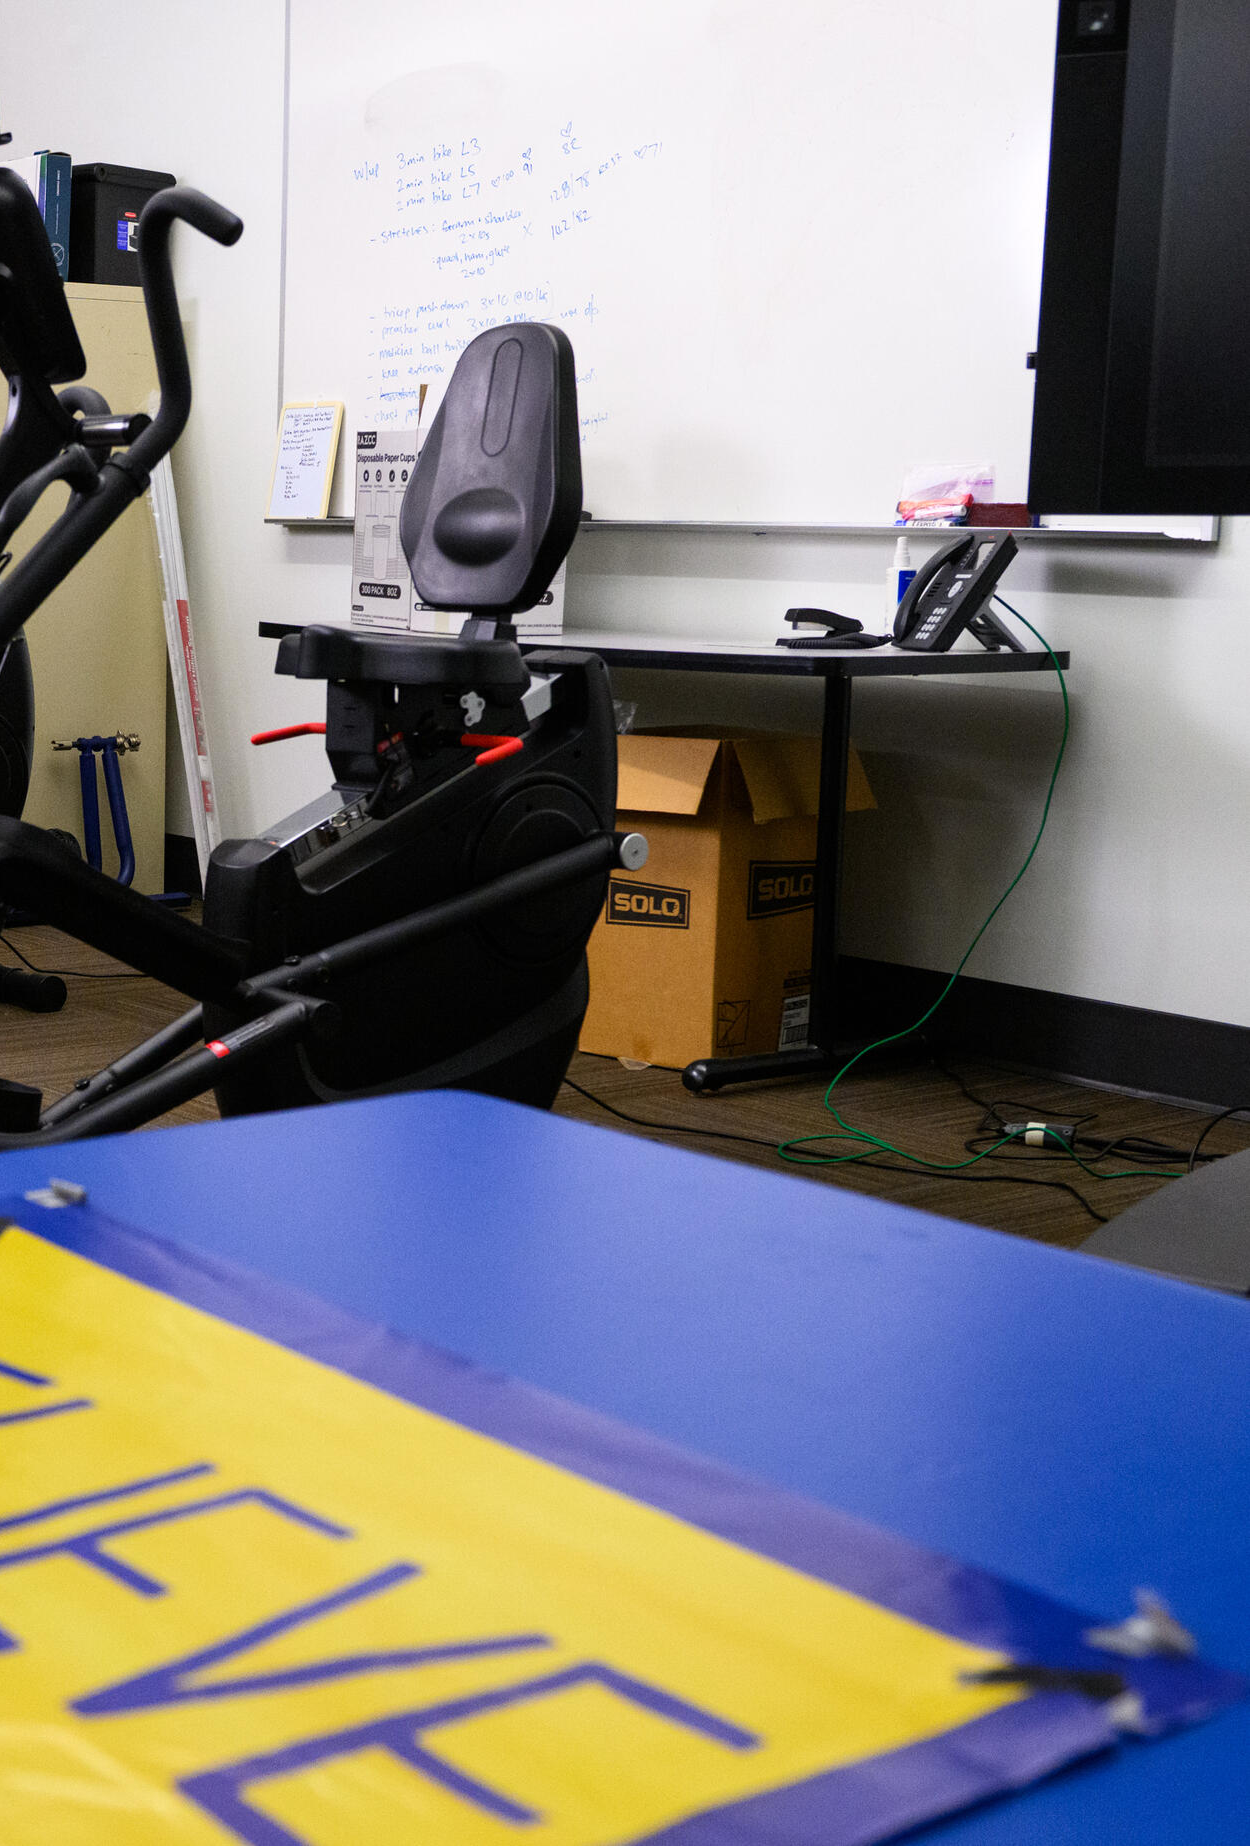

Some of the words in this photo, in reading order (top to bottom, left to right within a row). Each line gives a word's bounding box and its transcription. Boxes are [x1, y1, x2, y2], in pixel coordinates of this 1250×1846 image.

[433, 144, 452, 161] bike
[357, 452, 384, 465] Disposable
[384, 453, 400, 464] Paper
[399, 453, 416, 464] Cups
[371, 585, 384, 595] PACK
[614, 892, 681, 917] SOLO
